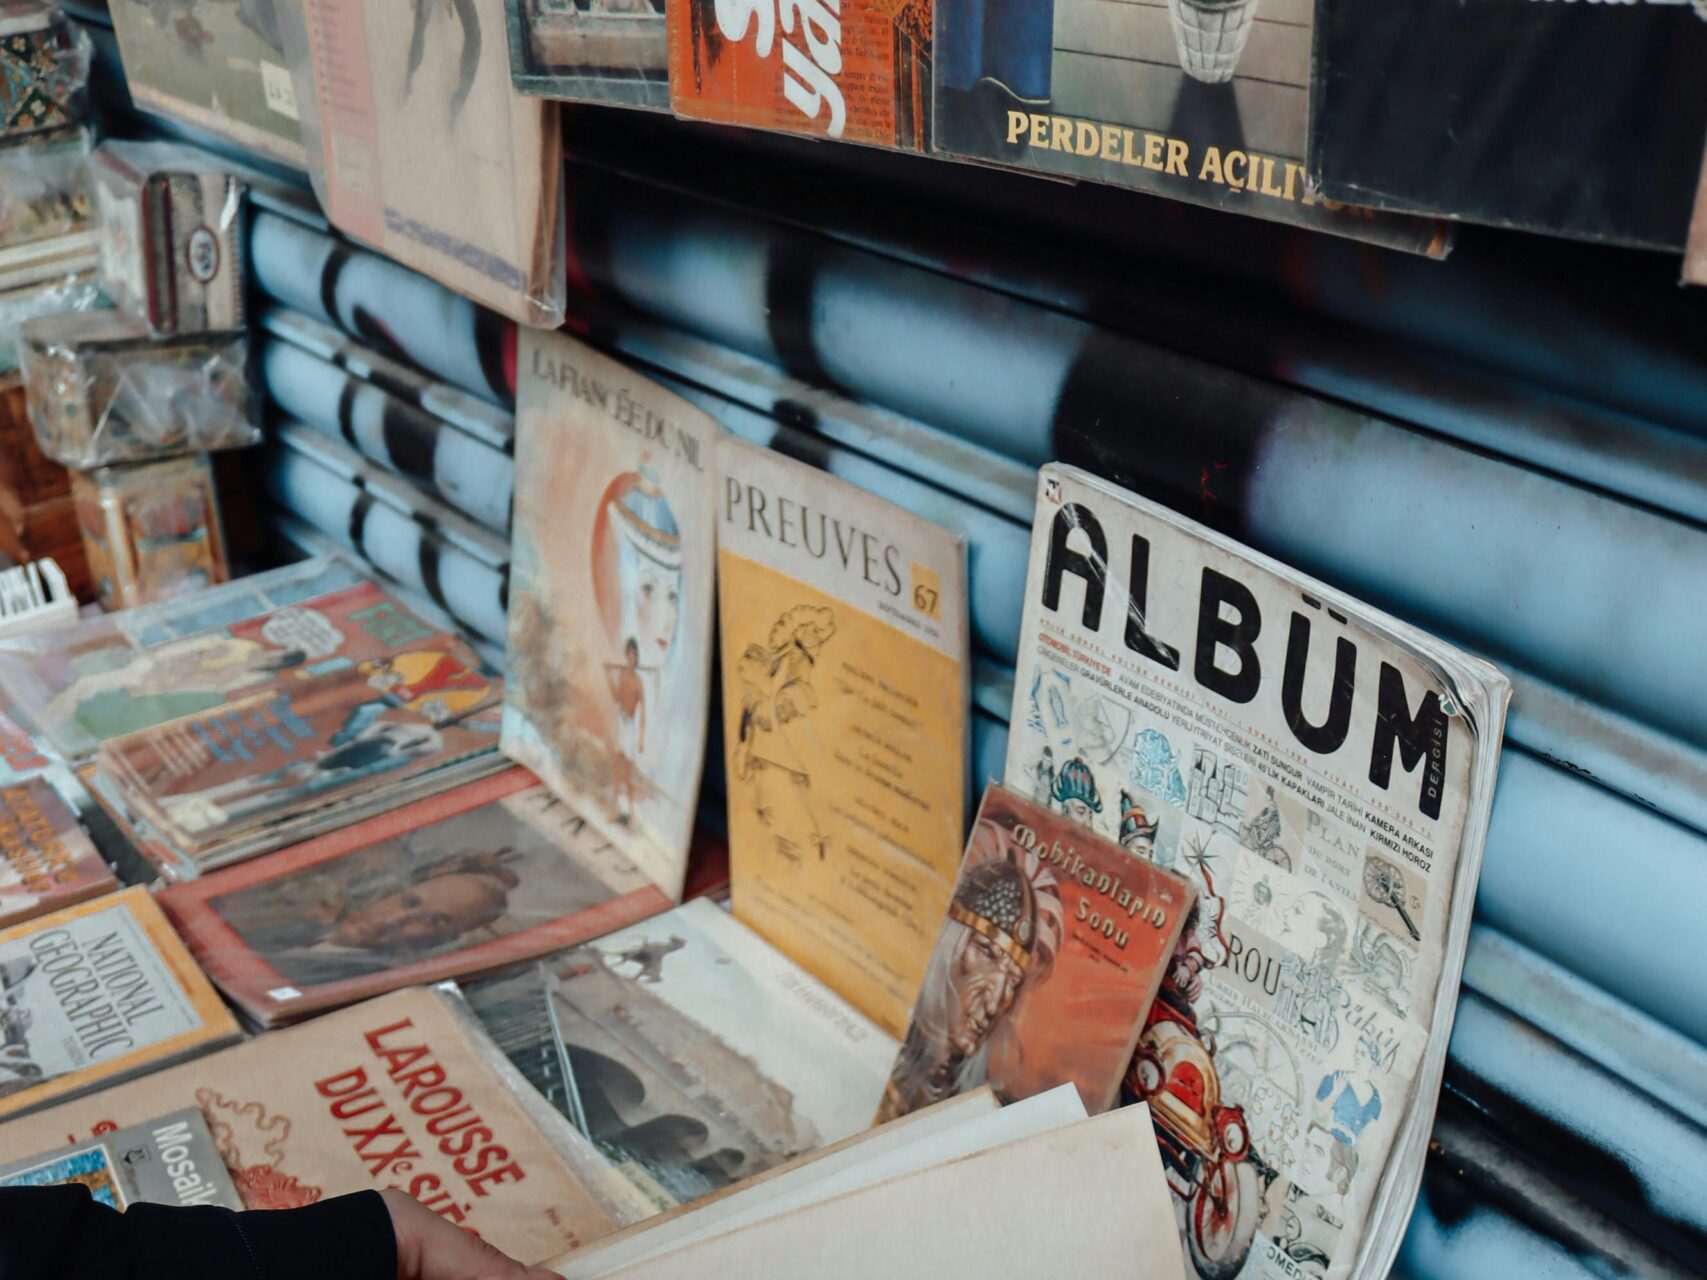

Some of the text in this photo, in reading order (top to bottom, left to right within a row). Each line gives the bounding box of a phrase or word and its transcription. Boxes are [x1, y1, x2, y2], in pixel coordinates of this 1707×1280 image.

[1006, 110, 1189, 177] PERDELER
[725, 476, 902, 597] PREUVES
[913, 585, 939, 614] 67
[1041, 502, 1449, 820] ALBÜM
[1134, 695, 1170, 721] ANADOLU
[1281, 776, 1325, 809] KAPAKLARI
[1370, 829, 1401, 855] KIRMIZI
[1402, 848, 1432, 873] HOROZ
[1271, 755, 1303, 781] SUNGUR
[1365, 809, 1401, 840] KAMERA
[1402, 832, 1434, 860] ARKASI
[29, 929, 134, 1059] GEOGRAPHIC
[83, 931, 164, 1028] NATIONAL
[314, 1066, 385, 1120] DU
[364, 1017, 526, 1197] LAROUSSE
